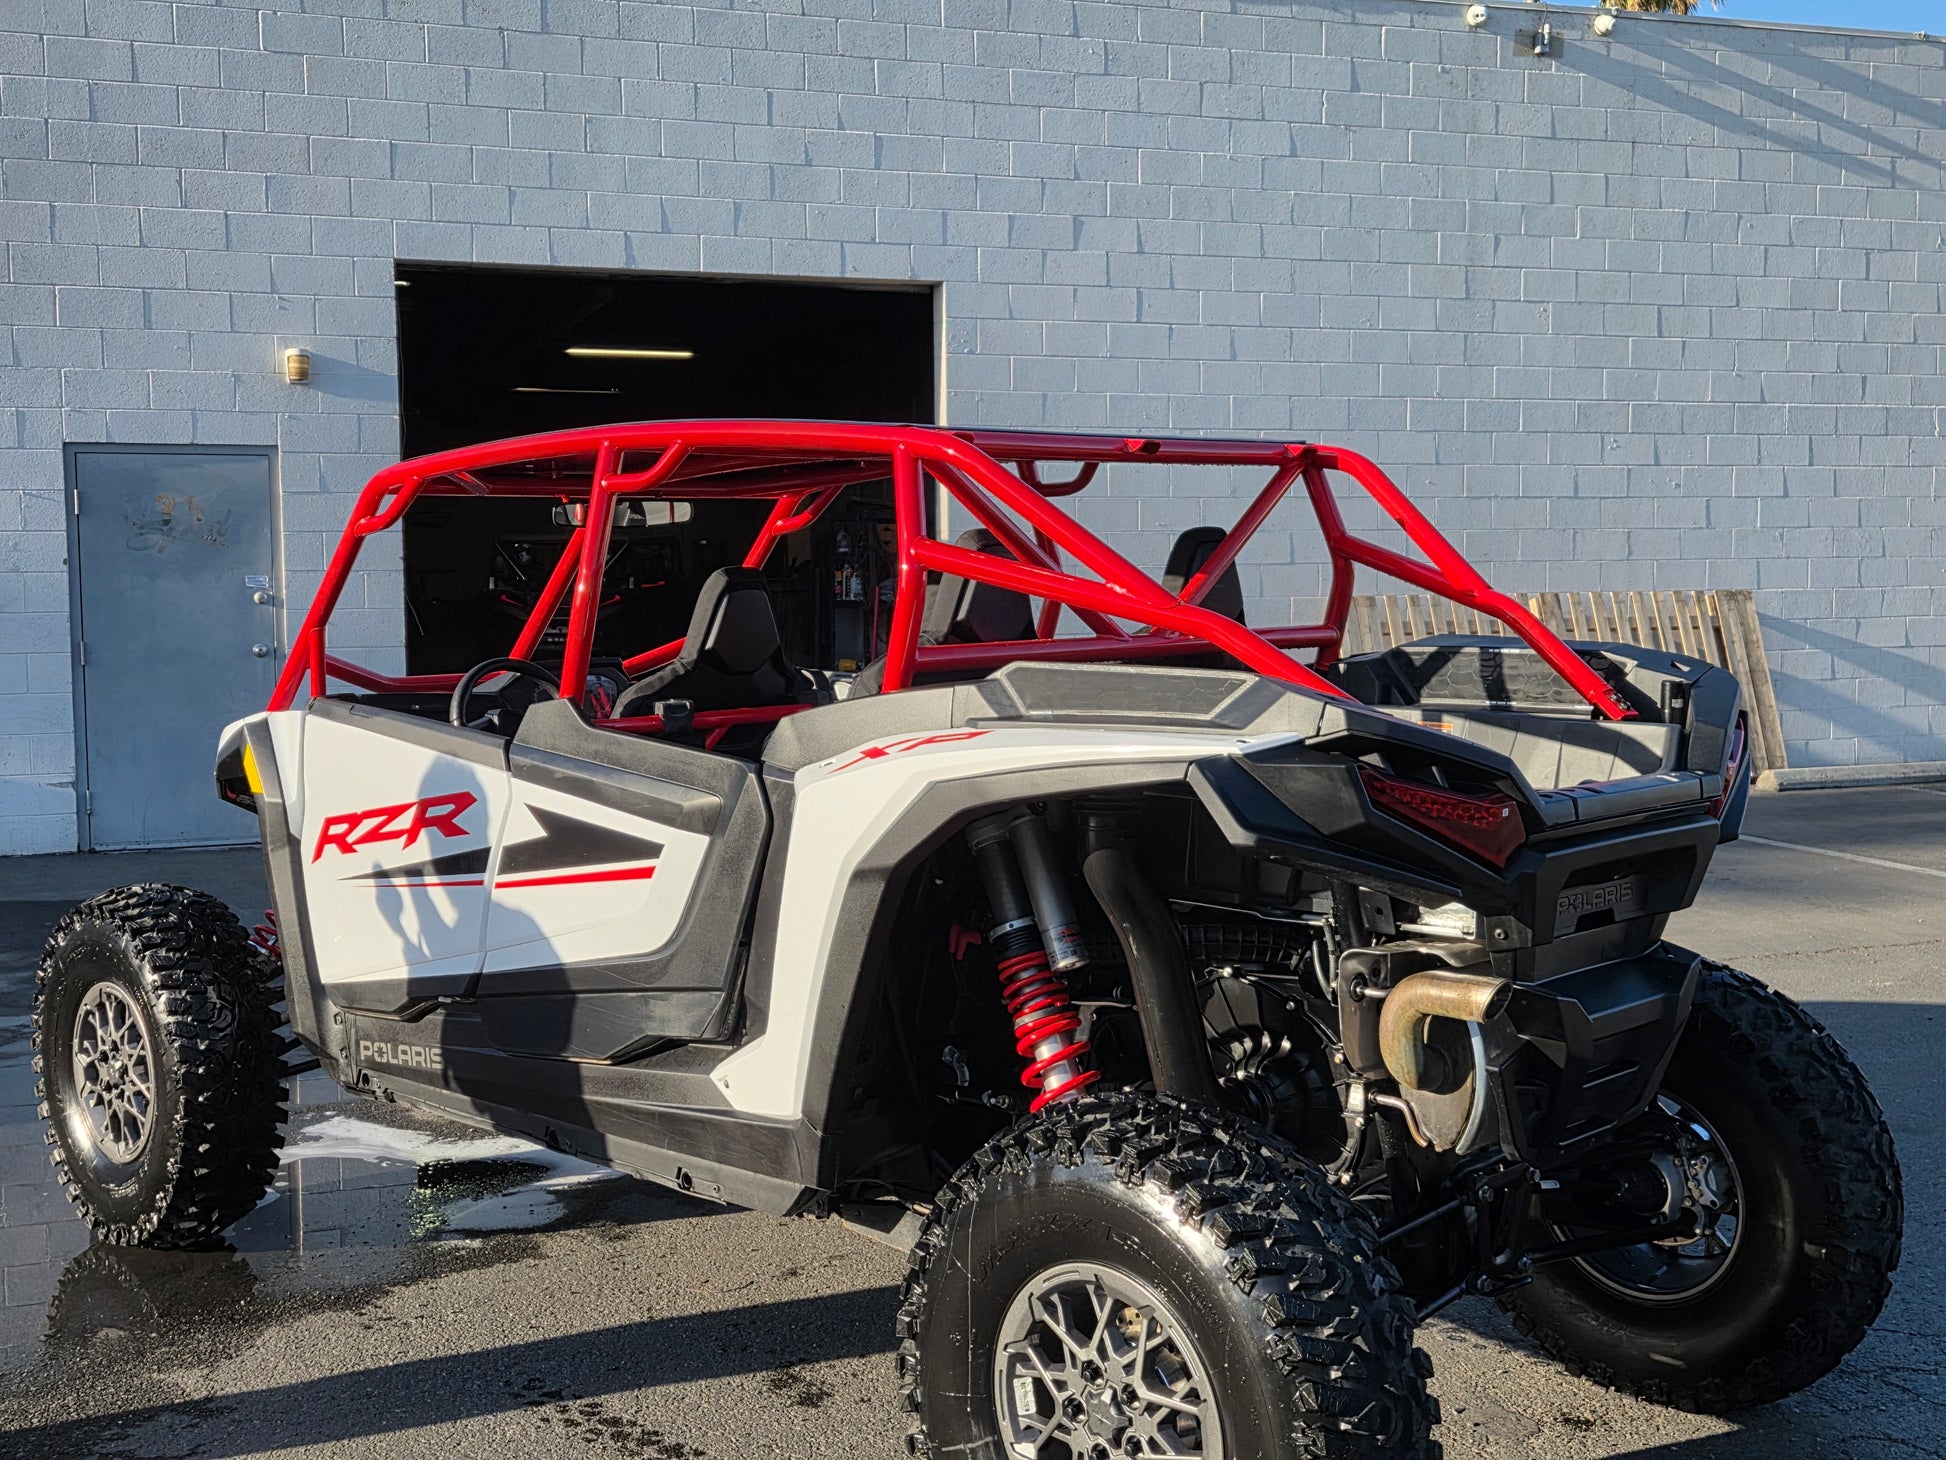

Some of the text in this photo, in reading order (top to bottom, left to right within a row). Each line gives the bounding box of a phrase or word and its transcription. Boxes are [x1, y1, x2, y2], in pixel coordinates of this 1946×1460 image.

[311, 790, 478, 865] RZR
[1558, 882, 1634, 917] POLARIS
[359, 1040, 445, 1070] POLARIS
